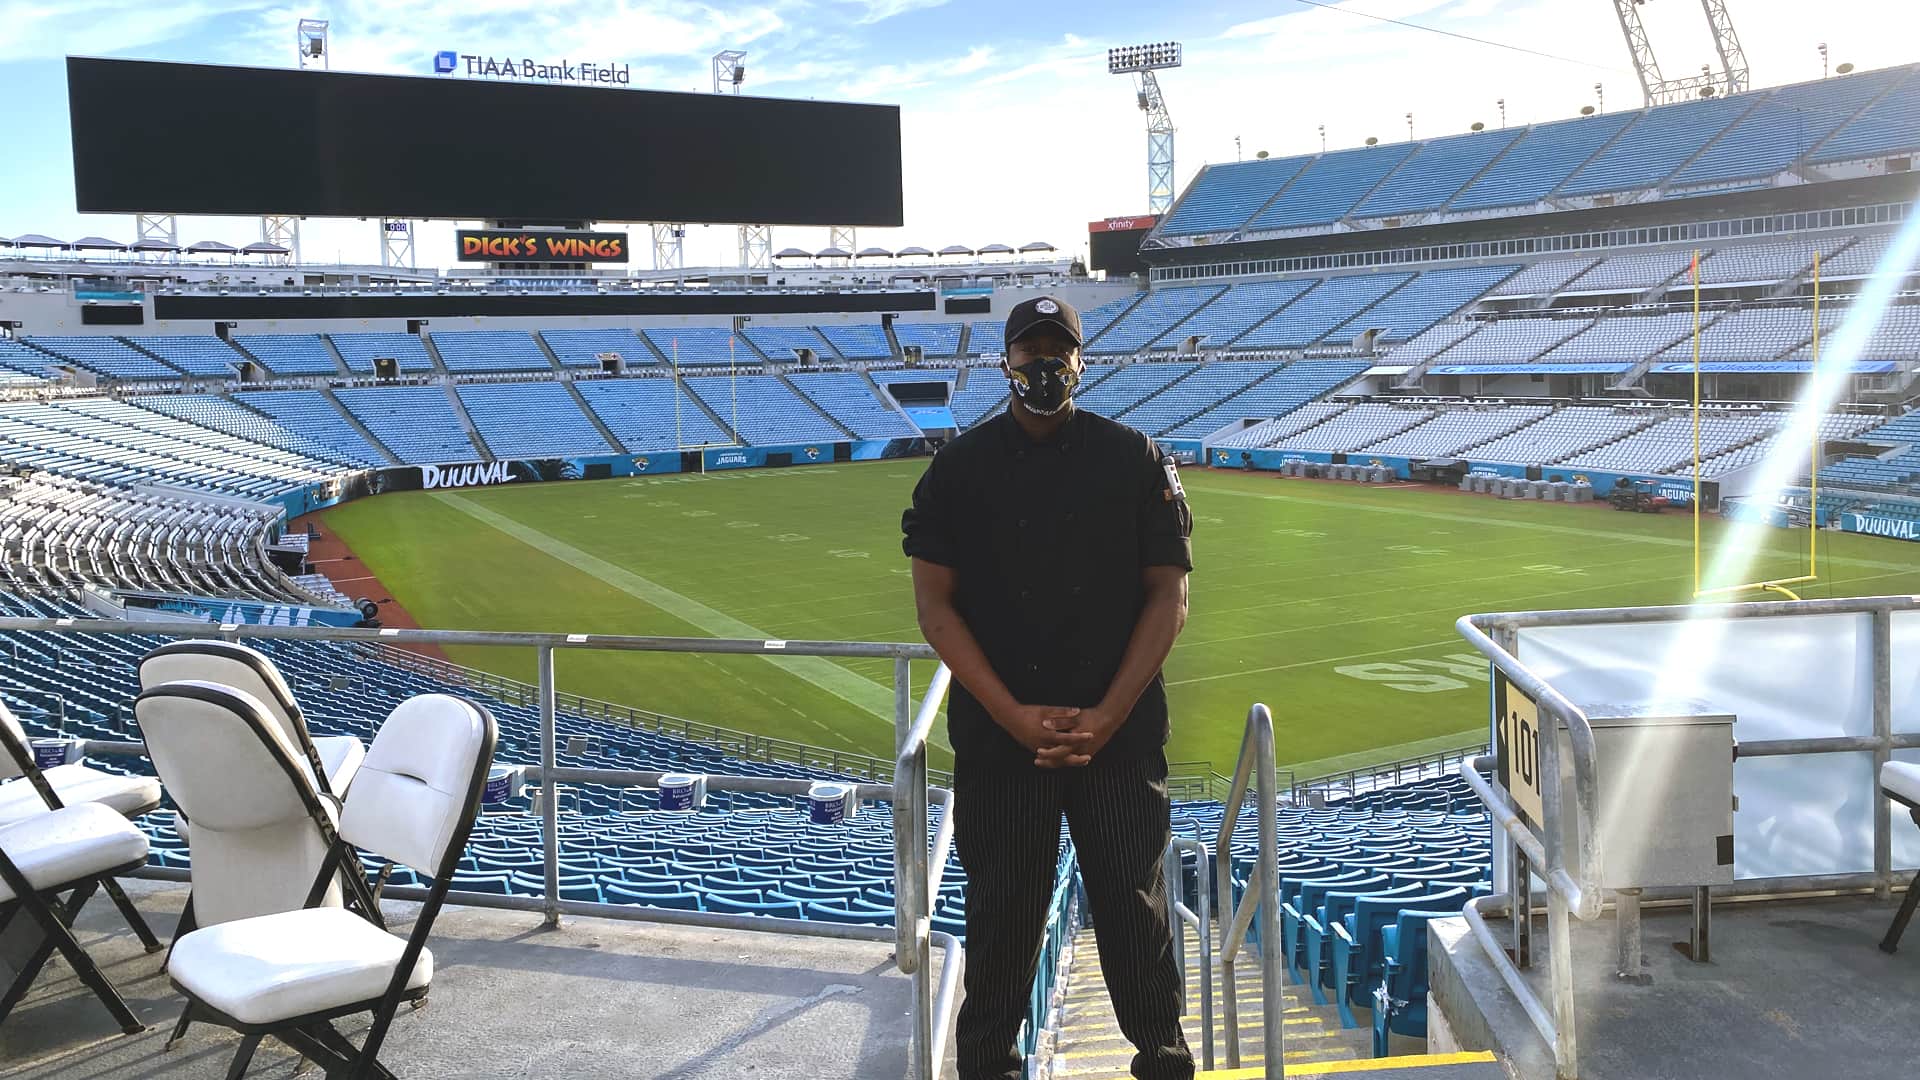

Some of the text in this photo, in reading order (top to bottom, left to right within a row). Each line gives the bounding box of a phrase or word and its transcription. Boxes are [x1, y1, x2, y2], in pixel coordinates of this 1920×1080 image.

[461, 55, 630, 84] TIAA Bank Field
[1107, 220, 1134, 231] xfinity
[463, 234, 622, 257] DICK'S WINGS
[716, 455, 747, 465] JAGUARS
[422, 461, 517, 489] DUUUVAL
[1856, 515, 1919, 539] DUUUVAL
[1512, 710, 1541, 797] 101
